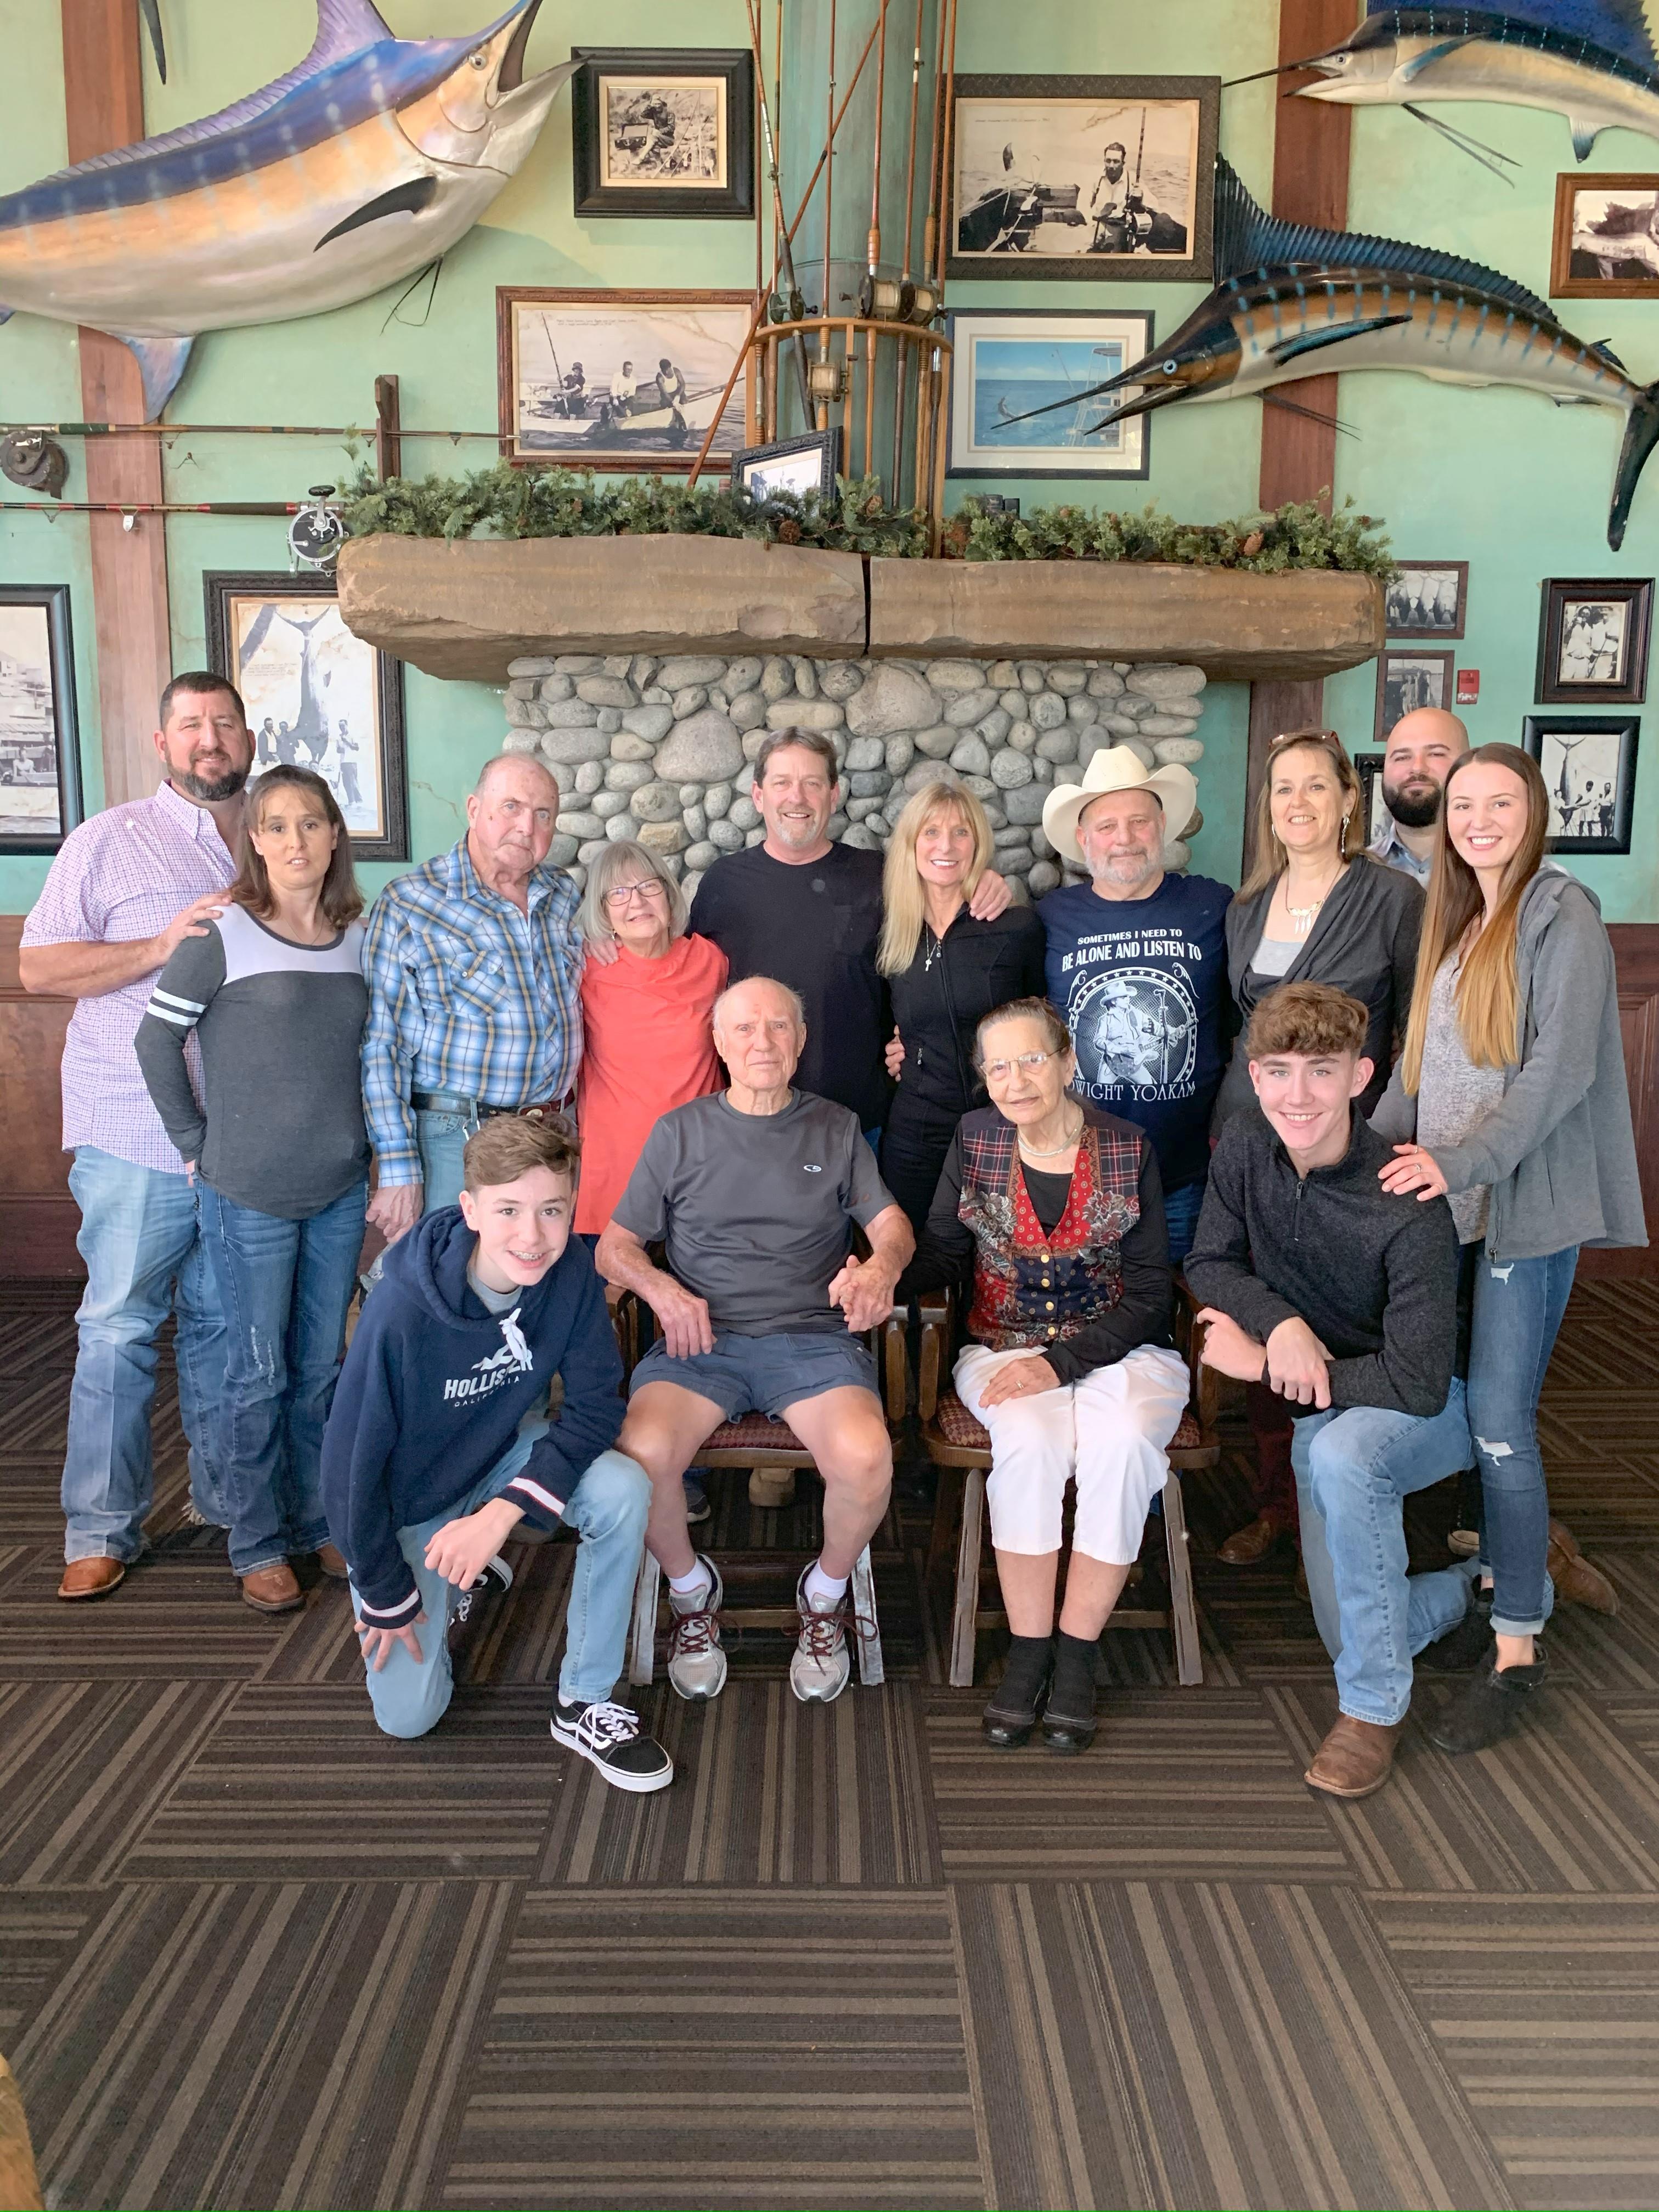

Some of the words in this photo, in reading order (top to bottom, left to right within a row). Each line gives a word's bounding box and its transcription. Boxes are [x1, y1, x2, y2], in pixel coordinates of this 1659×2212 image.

[1077, 931, 1132, 945] SOMETIMES
[1135, 930, 1138, 939] I
[1142, 929, 1167, 938] NEED
[1170, 929, 1182, 937] TO
[1062, 952, 1074, 972] BE
[1075, 945, 1113, 967] ALONE
[1115, 942, 1140, 959] AND
[1144, 940, 1184, 958] LISTEN
[1188, 943, 1202, 961] TO
[1131, 1080, 1196, 1102] YOAKAM
